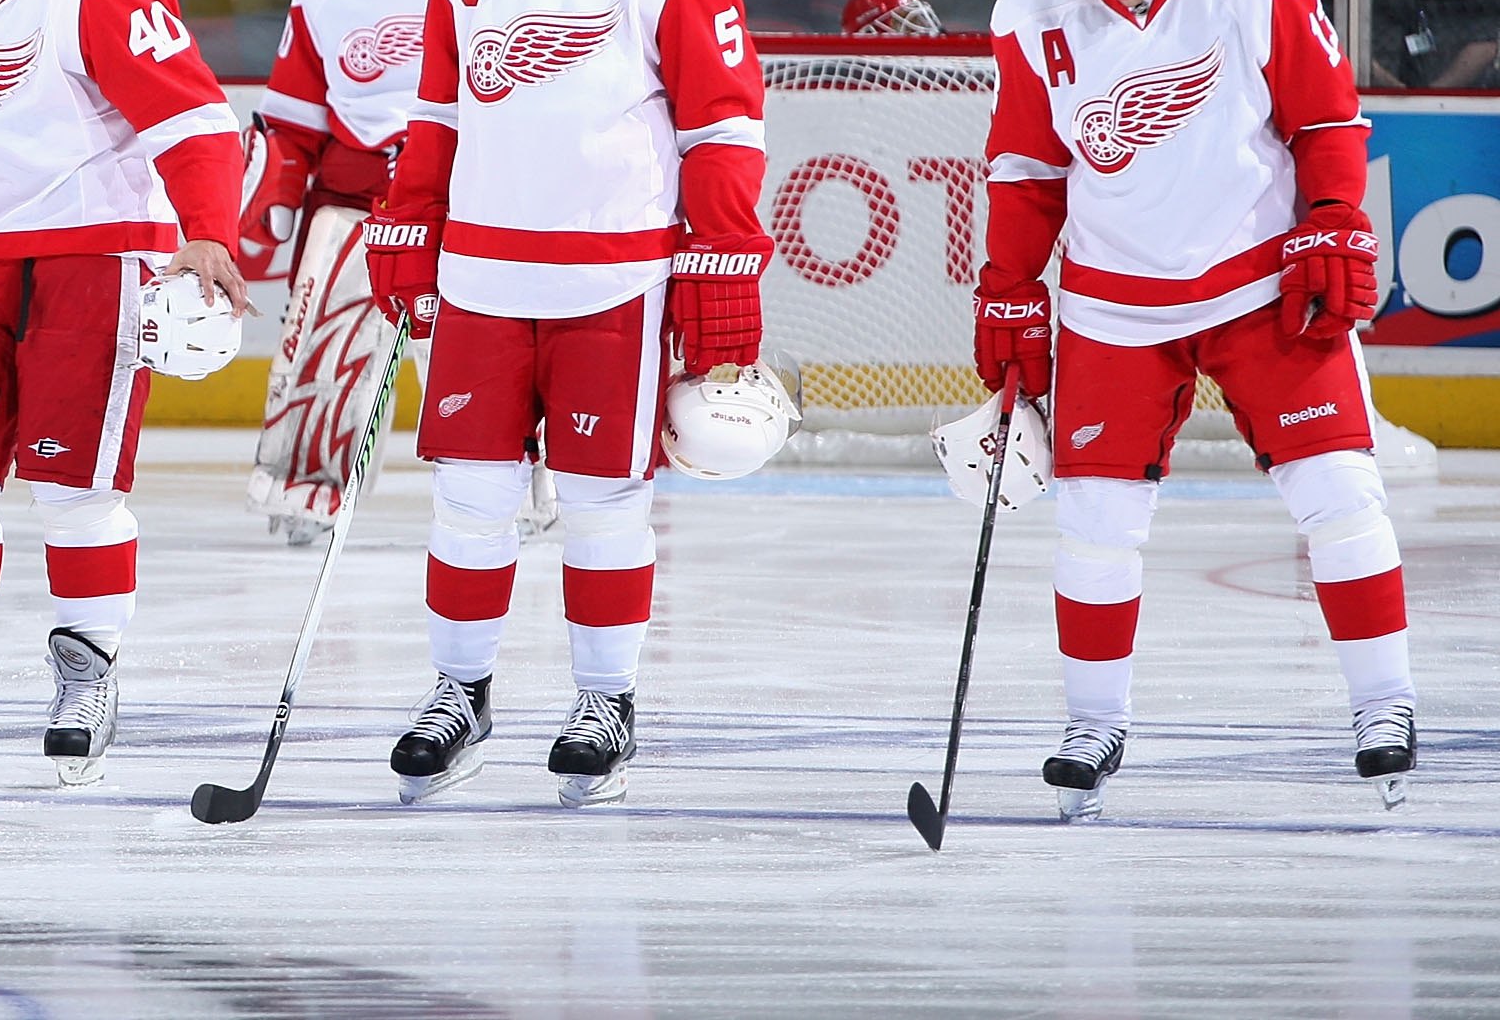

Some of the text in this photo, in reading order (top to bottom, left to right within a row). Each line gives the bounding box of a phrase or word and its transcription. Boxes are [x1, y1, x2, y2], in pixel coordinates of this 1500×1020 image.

[129, 0, 191, 63] 40
[713, 6, 744, 68] 5
[1041, 27, 1077, 88] A
[141, 318, 159, 343] 40
[1280, 402, 1339, 428] Reebok
